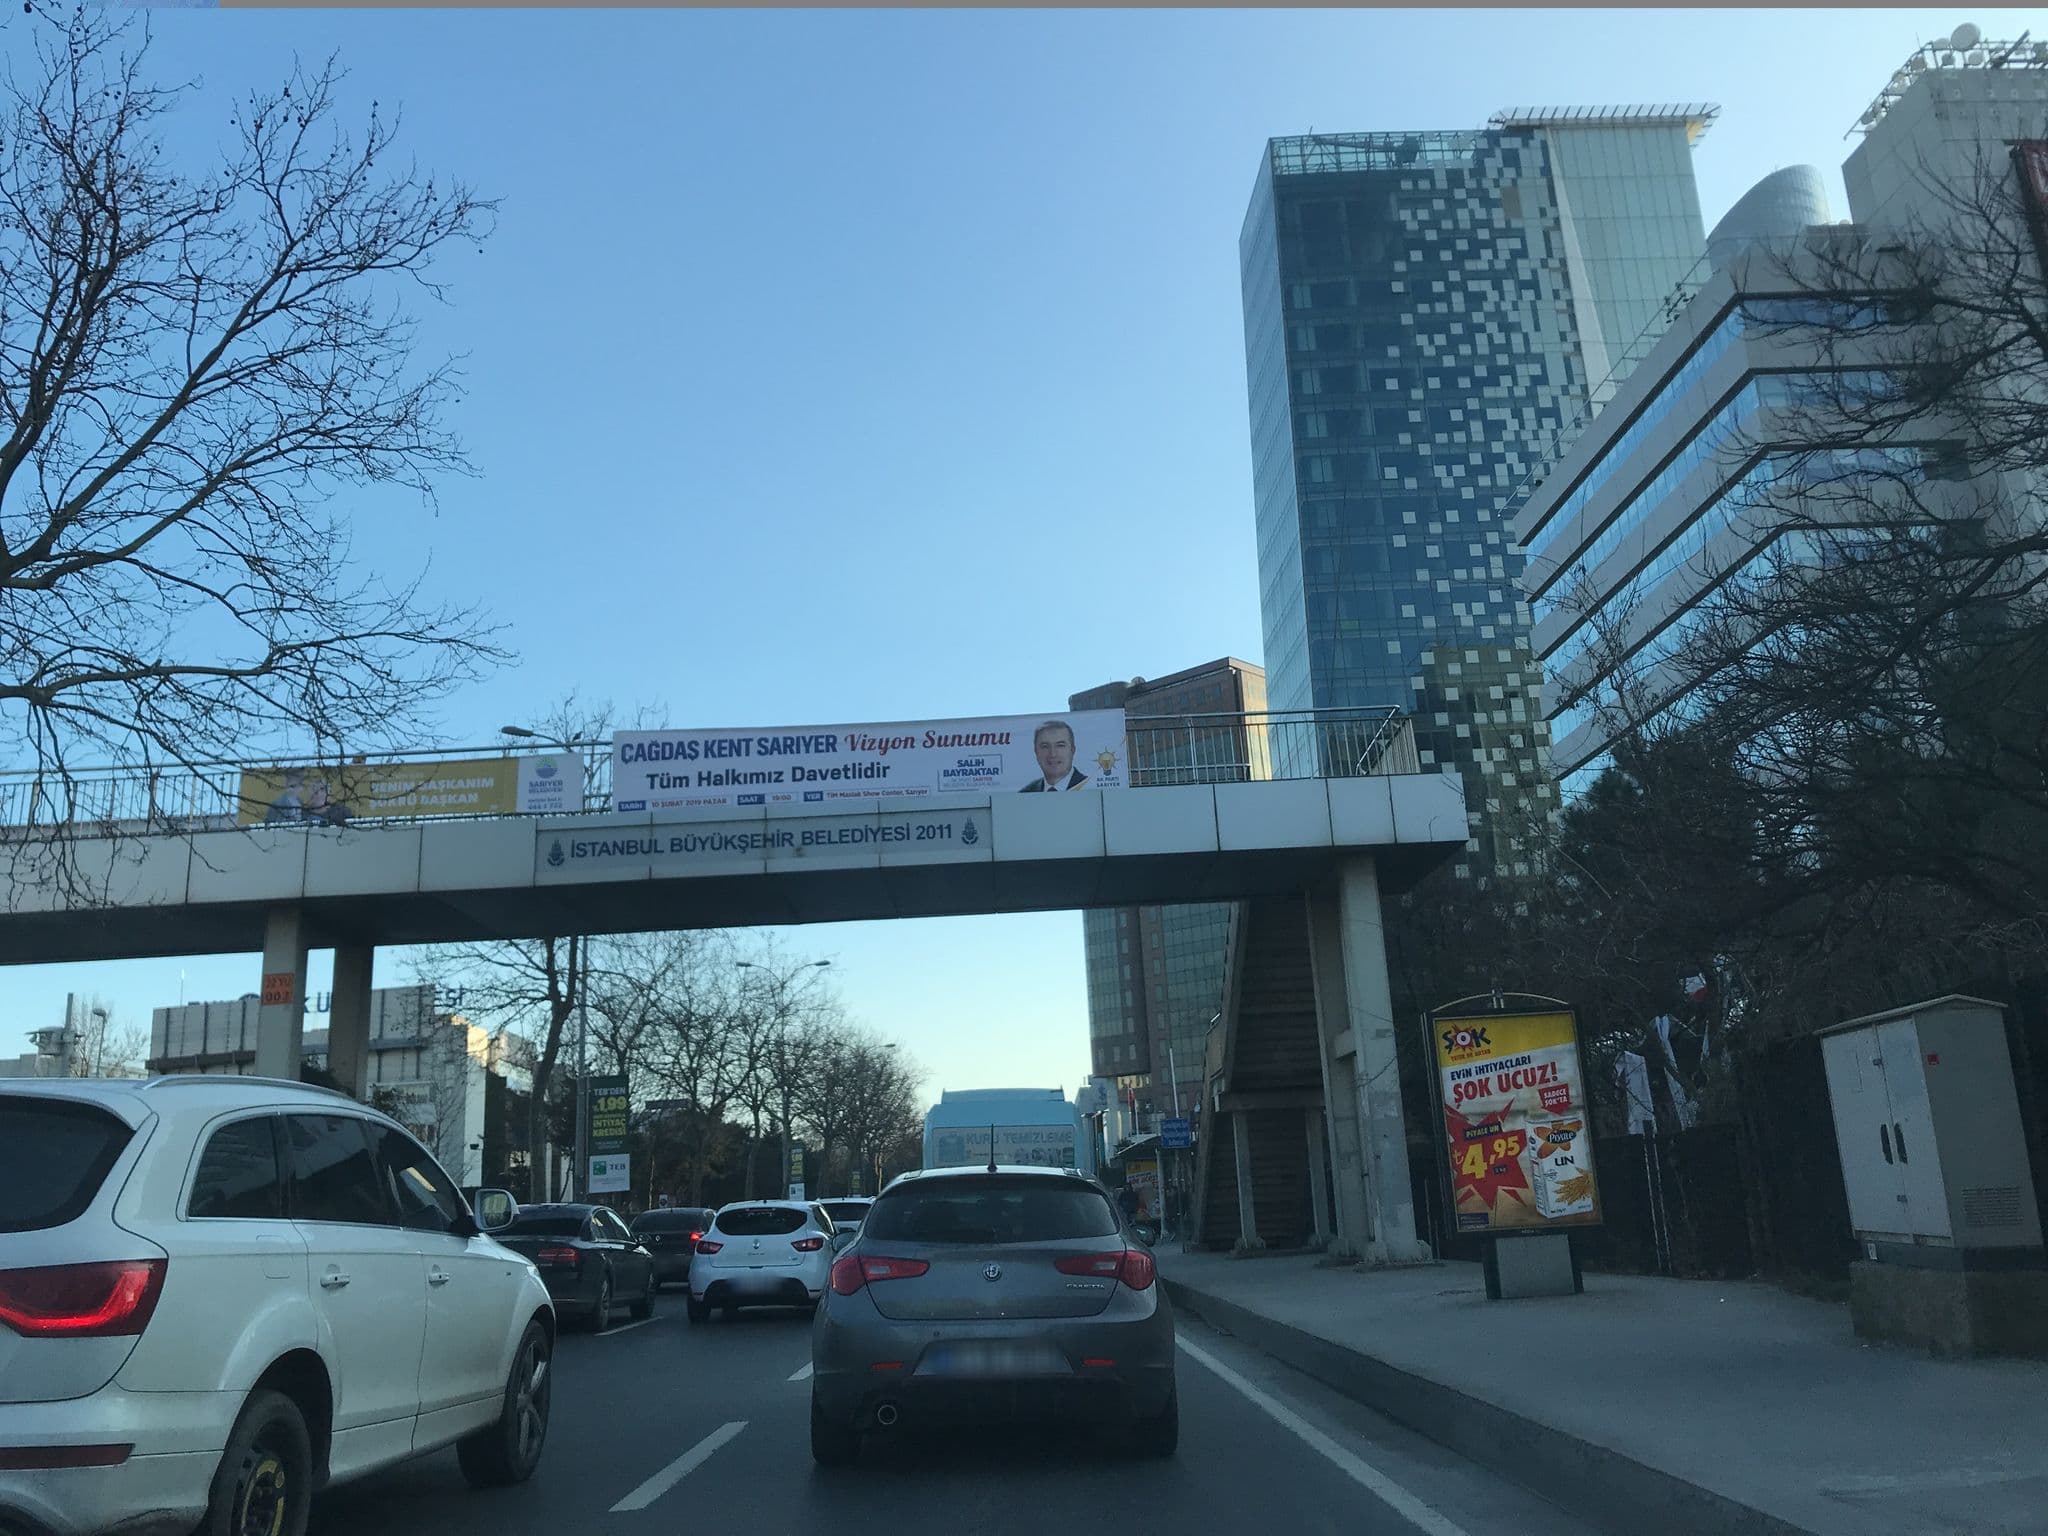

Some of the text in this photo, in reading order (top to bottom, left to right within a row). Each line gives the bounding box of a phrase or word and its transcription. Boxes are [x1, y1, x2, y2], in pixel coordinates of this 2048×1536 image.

[620, 729, 1013, 764] ÇAĞDAŞ KENT SARIYER Vizyon Sunumu
[646, 761, 891, 789] Tüm Halkımız Davetlidir
[943, 767, 1000, 778] BAYRAKTAR
[620, 801, 643, 811] TARİH
[703, 798, 727, 806] PAZAR
[570, 822, 952, 858] İSTANBUL BÜYÜKŞEHİR BELEDİYESİ 2011
[1450, 1054, 1532, 1081] EVİN İHTİYAÇLARI
[1453, 1061, 1559, 1110] ŞOK UCUZ!
[1543, 1088, 1568, 1100] SADECE
[1554, 1156, 1575, 1167] UN
